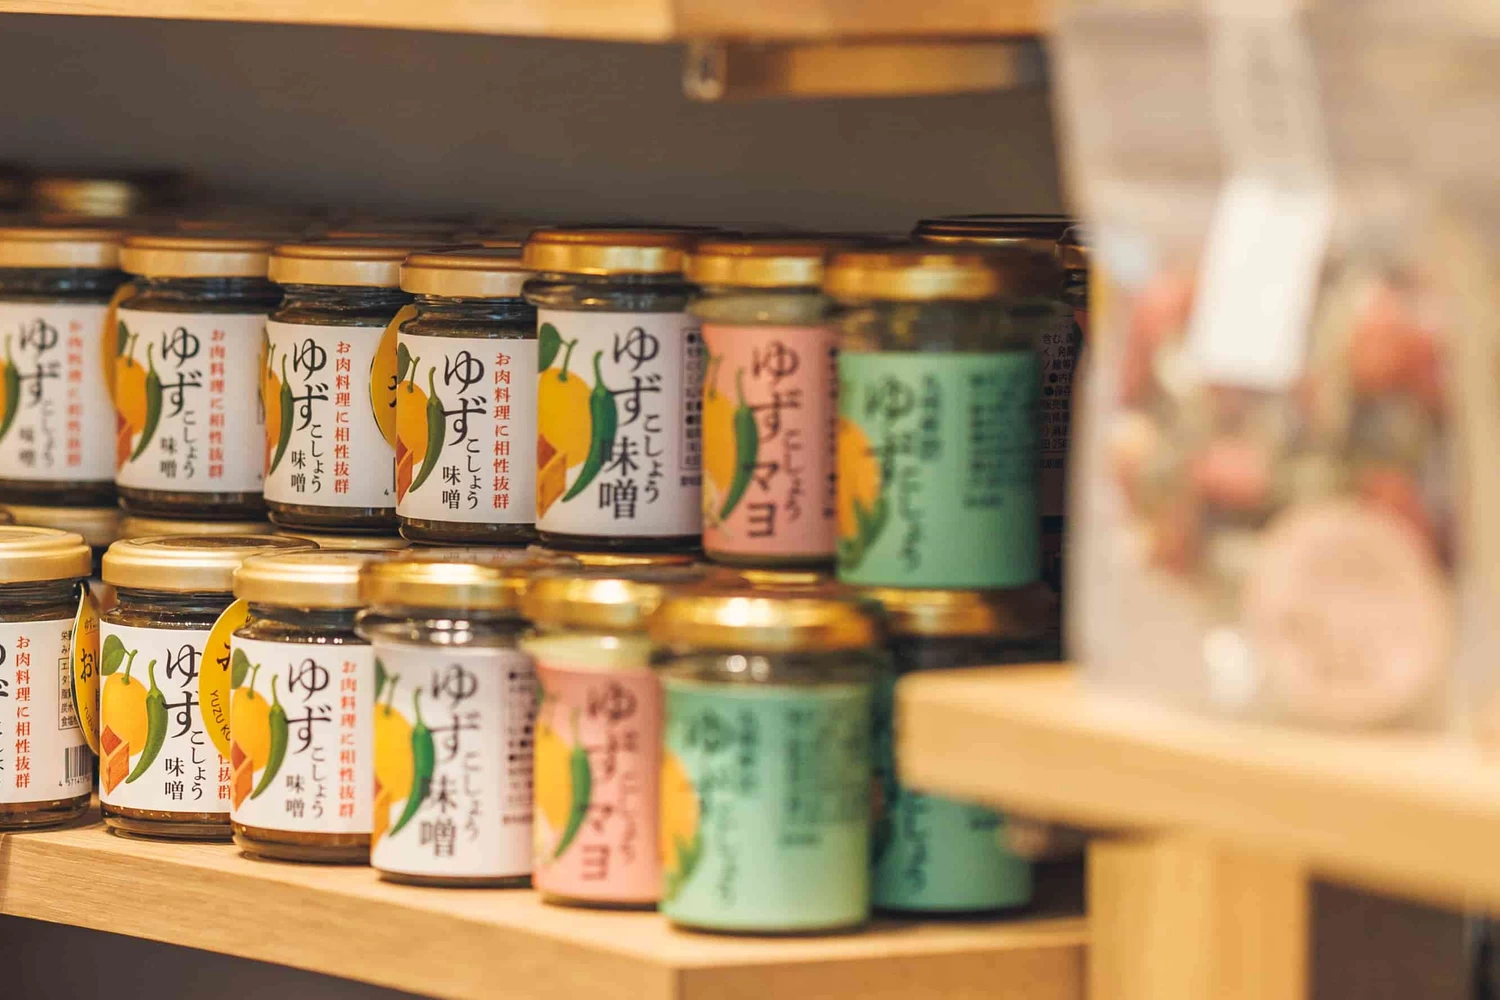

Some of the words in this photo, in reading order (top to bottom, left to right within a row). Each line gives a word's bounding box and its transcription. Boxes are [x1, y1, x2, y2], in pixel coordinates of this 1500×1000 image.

[18, 318, 61, 407] ゆず
[161, 327, 202, 419] ゆず
[209, 329, 226, 479] お肉料理に相性抜群
[292, 338, 329, 432] ゆず
[441, 350, 487, 447] ゆず
[160, 436, 177, 479] 味噌
[182, 410, 198, 480] こしょう
[310, 423, 325, 494] こしょう
[333, 341, 351, 494] お肉料理に相性抜群
[492, 352, 512, 510] お肉料理に相性抜群
[642, 414, 664, 504] こしょう
[290, 449, 306, 494] 味噌
[441, 466, 461, 510] 味噌
[465, 438, 483, 510] こしょう
[14, 635, 31, 789] お肉料理に相性抜群
[161, 644, 202, 739] ゆず
[210, 689, 225, 724] YUZU
[284, 658, 332, 755] ゆず
[164, 757, 185, 801] 味噌
[190, 730, 207, 801] こしょう
[310, 747, 327, 818] こしょう
[339, 660, 357, 818] お肉料理に相性抜群
[285, 773, 305, 818] 味噌
